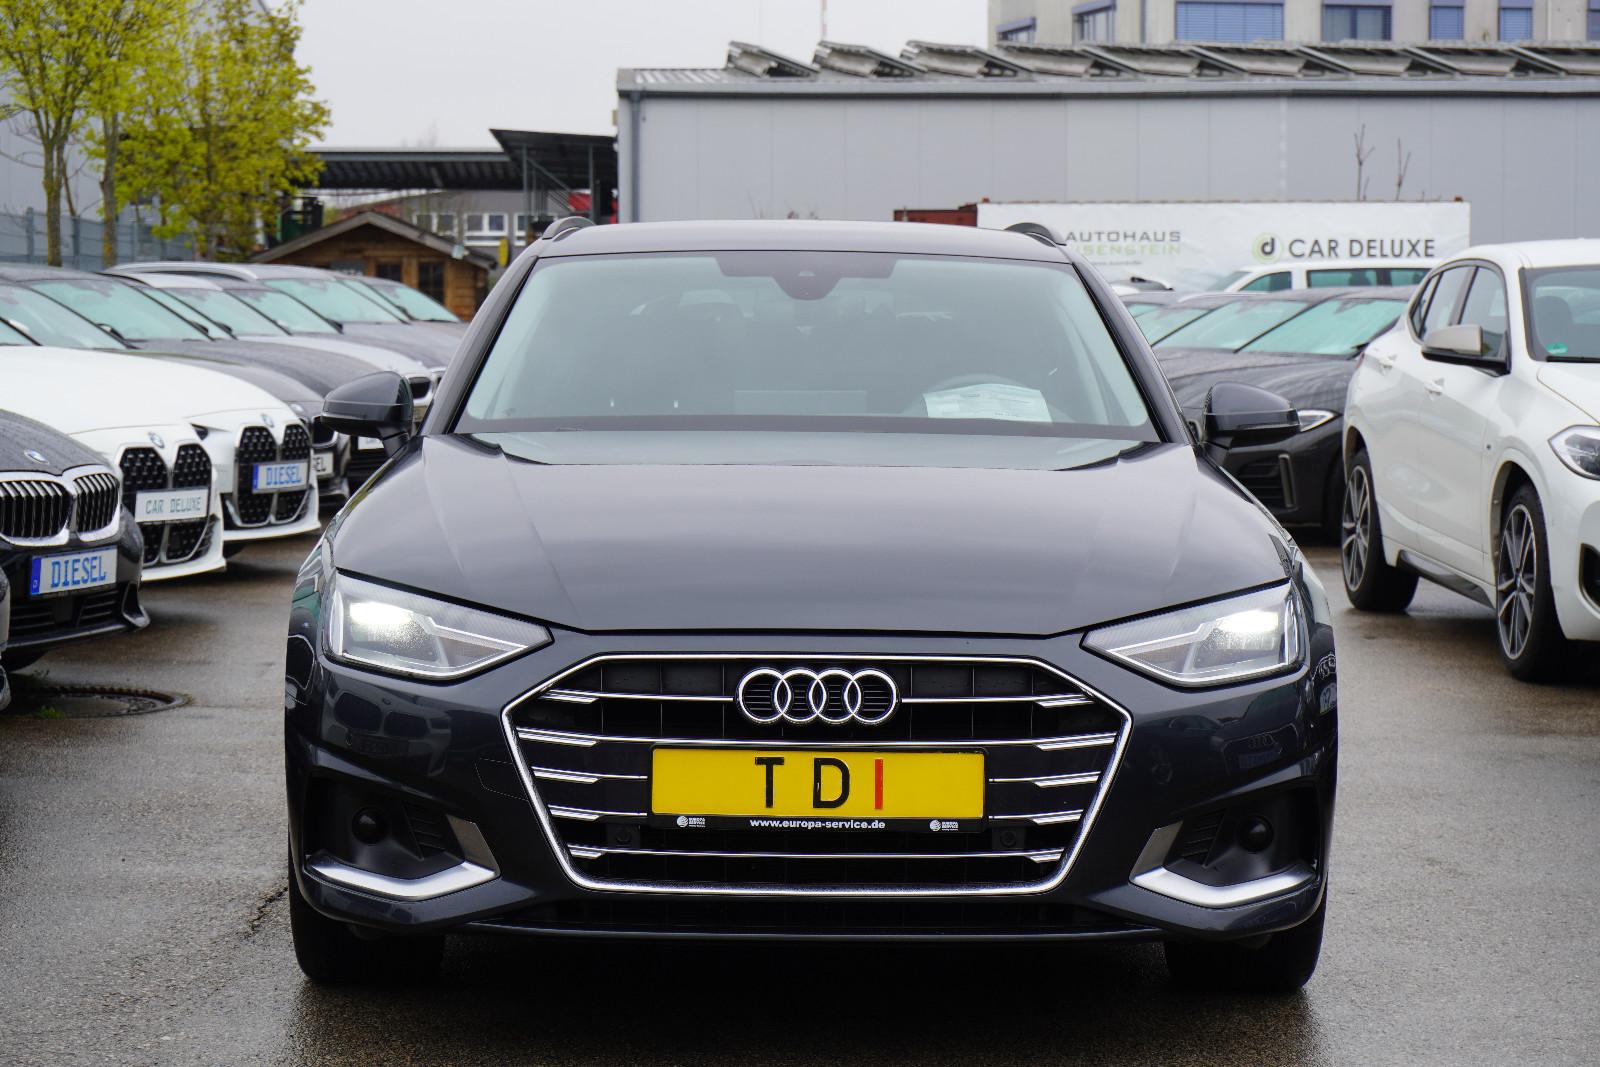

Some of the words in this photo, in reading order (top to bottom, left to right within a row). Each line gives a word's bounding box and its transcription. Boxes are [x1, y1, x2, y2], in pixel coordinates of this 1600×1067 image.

[1065, 231, 1182, 243] AUTOHAUS
[1074, 243, 1181, 257] ISENSTEIN
[1288, 239, 1339, 258] CAR
[1350, 239, 1436, 258] DELUXE
[265, 464, 303, 486] DIESEL
[145, 499, 164, 514] CAR
[170, 496, 202, 513] DELUXE
[51, 555, 107, 588] DIESEL
[749, 819, 886, 830] www.europa-service.de
